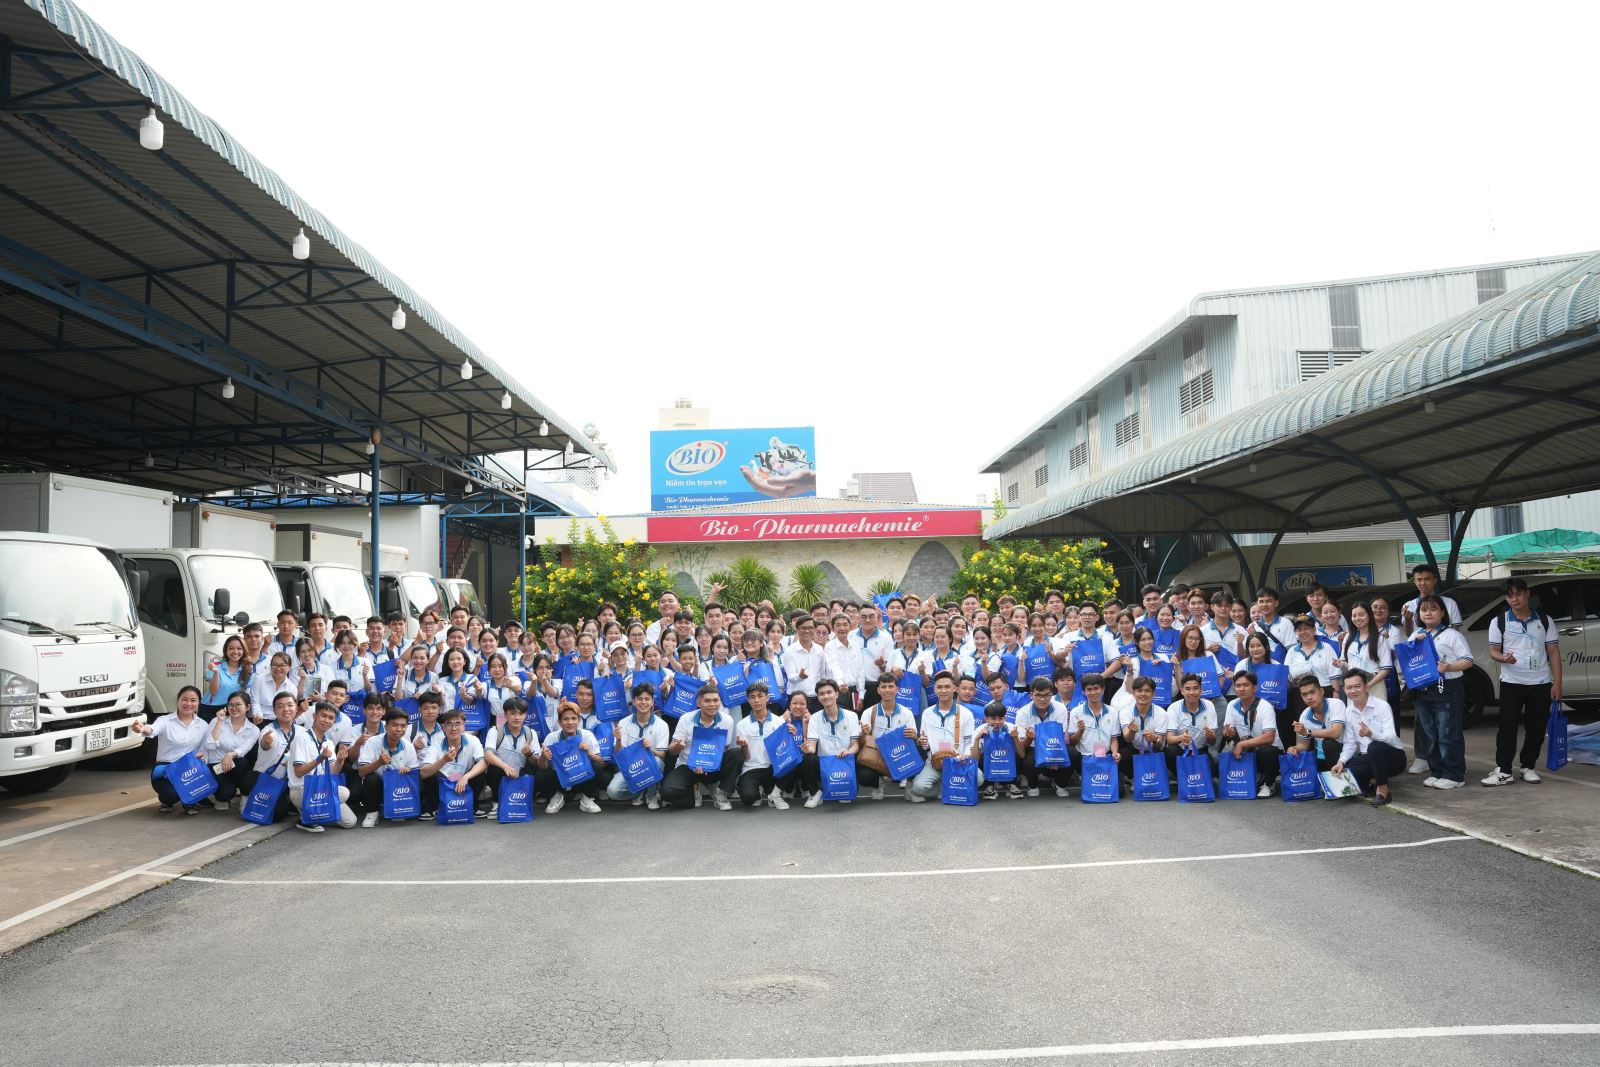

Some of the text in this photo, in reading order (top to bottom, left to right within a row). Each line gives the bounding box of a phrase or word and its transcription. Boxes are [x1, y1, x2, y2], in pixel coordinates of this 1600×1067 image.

[674, 442, 716, 465] BIO
[700, 520, 739, 536] Bio
[1288, 574, 1310, 588] BIO
[80, 674, 108, 684] ISUZU
